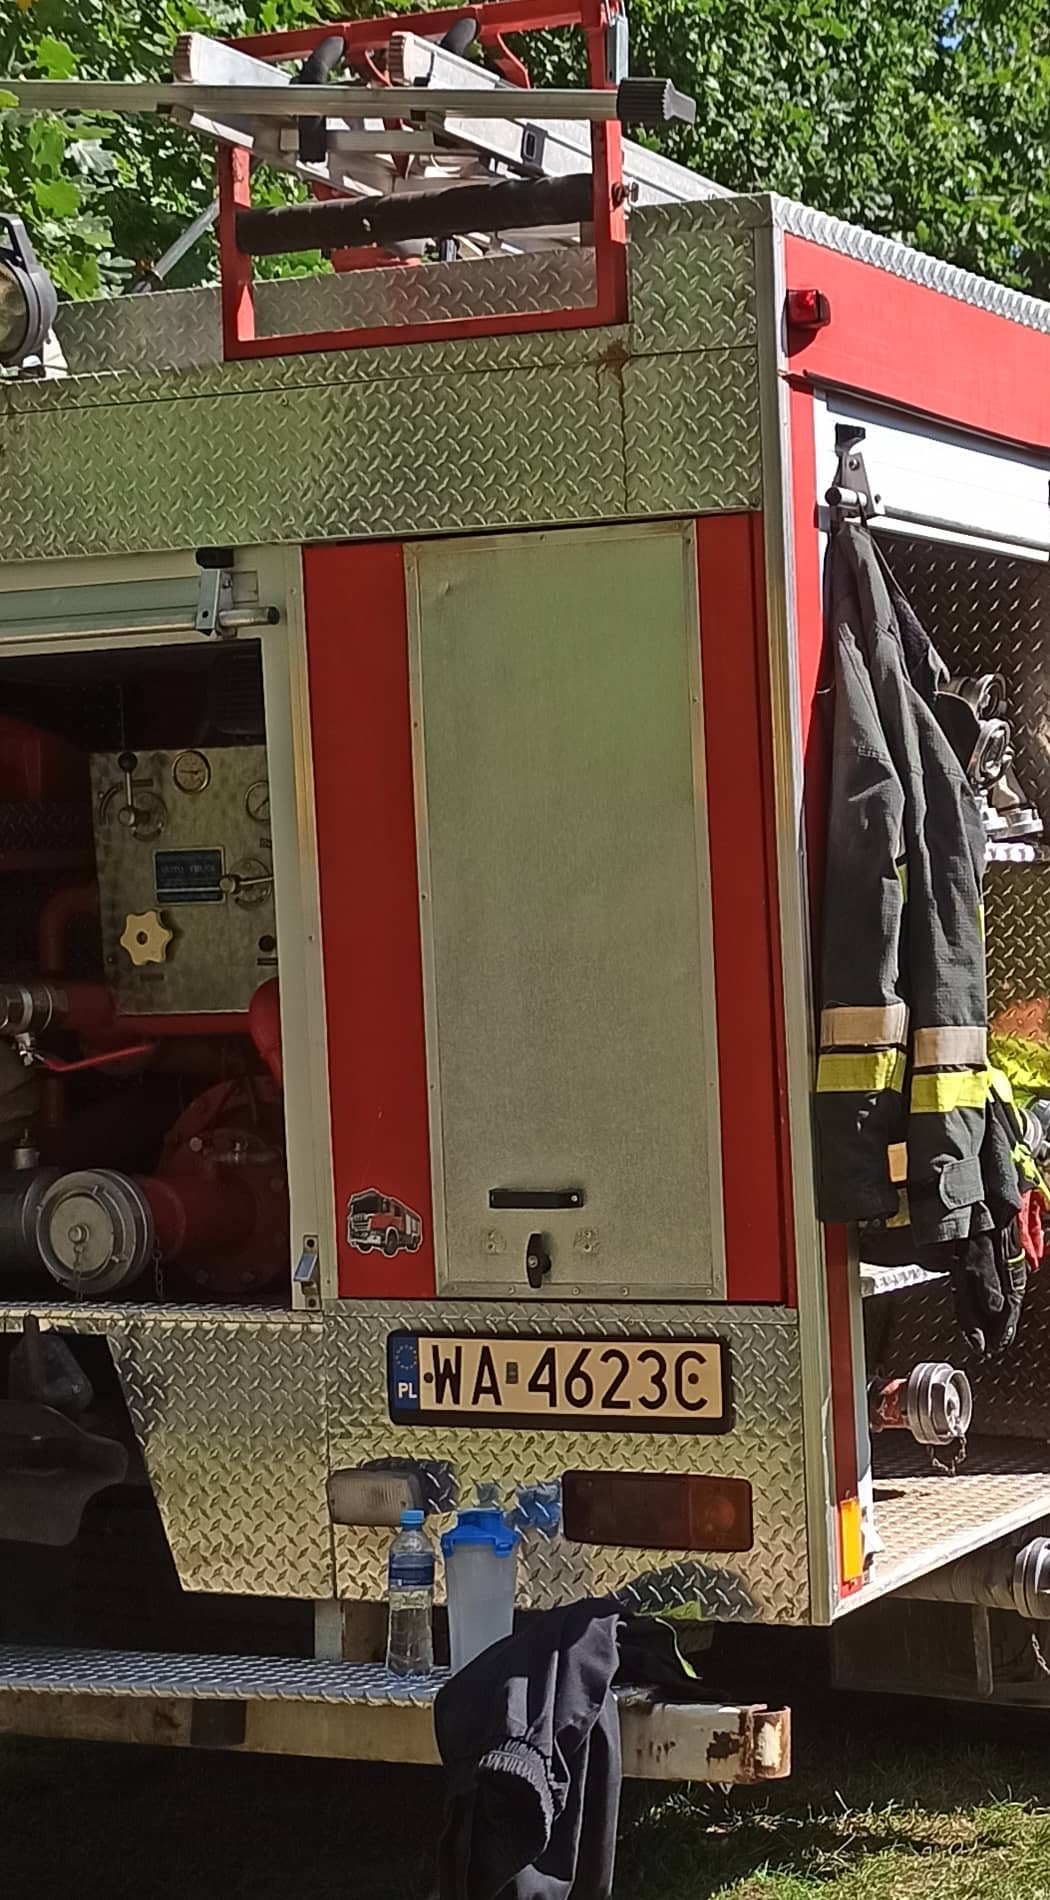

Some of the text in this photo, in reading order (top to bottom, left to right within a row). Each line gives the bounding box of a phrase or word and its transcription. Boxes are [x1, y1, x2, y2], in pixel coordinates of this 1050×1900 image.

[398, 1381, 418, 1399] PL
[431, 1344, 708, 1411] WA 4623C
